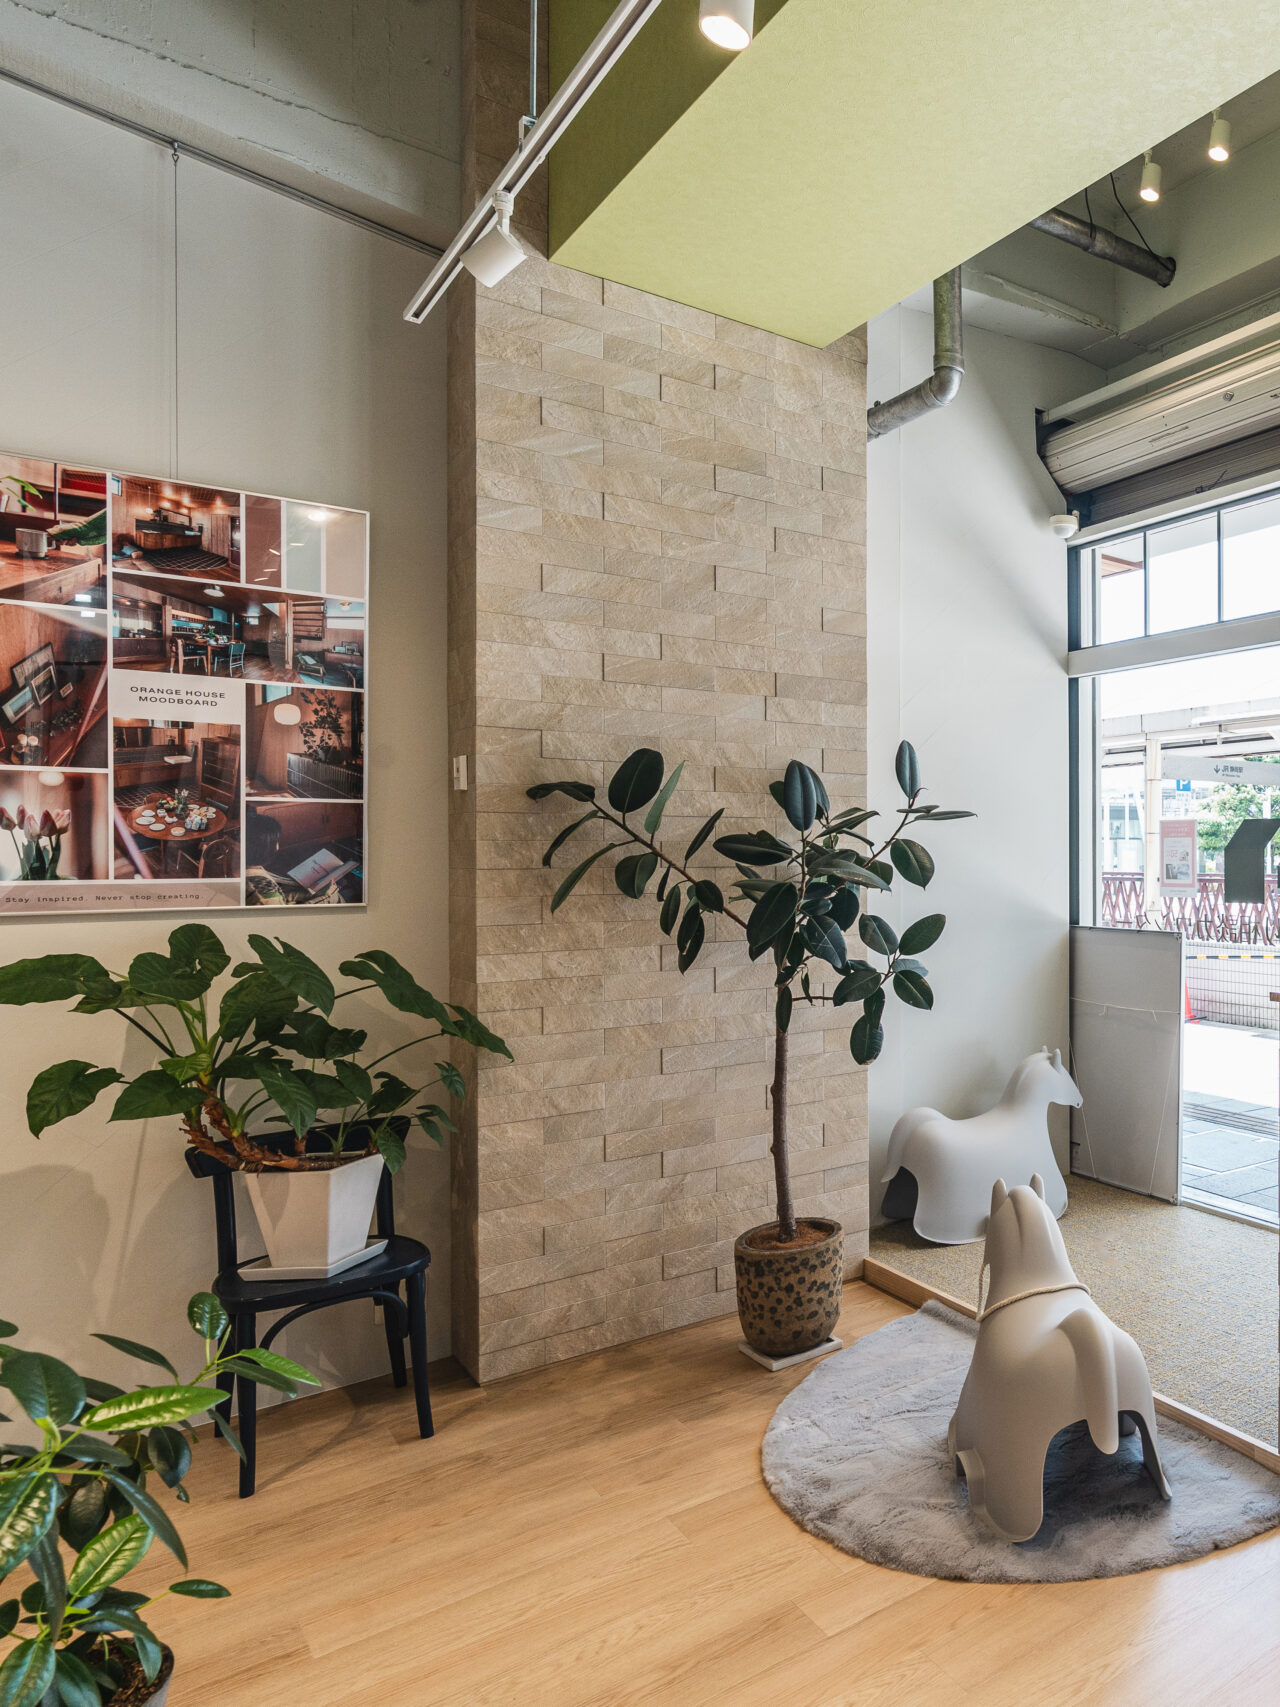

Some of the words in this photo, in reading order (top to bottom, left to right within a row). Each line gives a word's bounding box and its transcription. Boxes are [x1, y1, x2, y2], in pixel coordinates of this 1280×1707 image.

[130, 686, 182, 696] ORANGE
[186, 690, 226, 699] HOUSE
[138, 696, 218, 707] MOODBOARD
[5, 896, 30, 904] Stay
[37, 895, 88, 904] inspired.
[130, 893, 152, 901] stop
[157, 892, 204, 900] creating.
